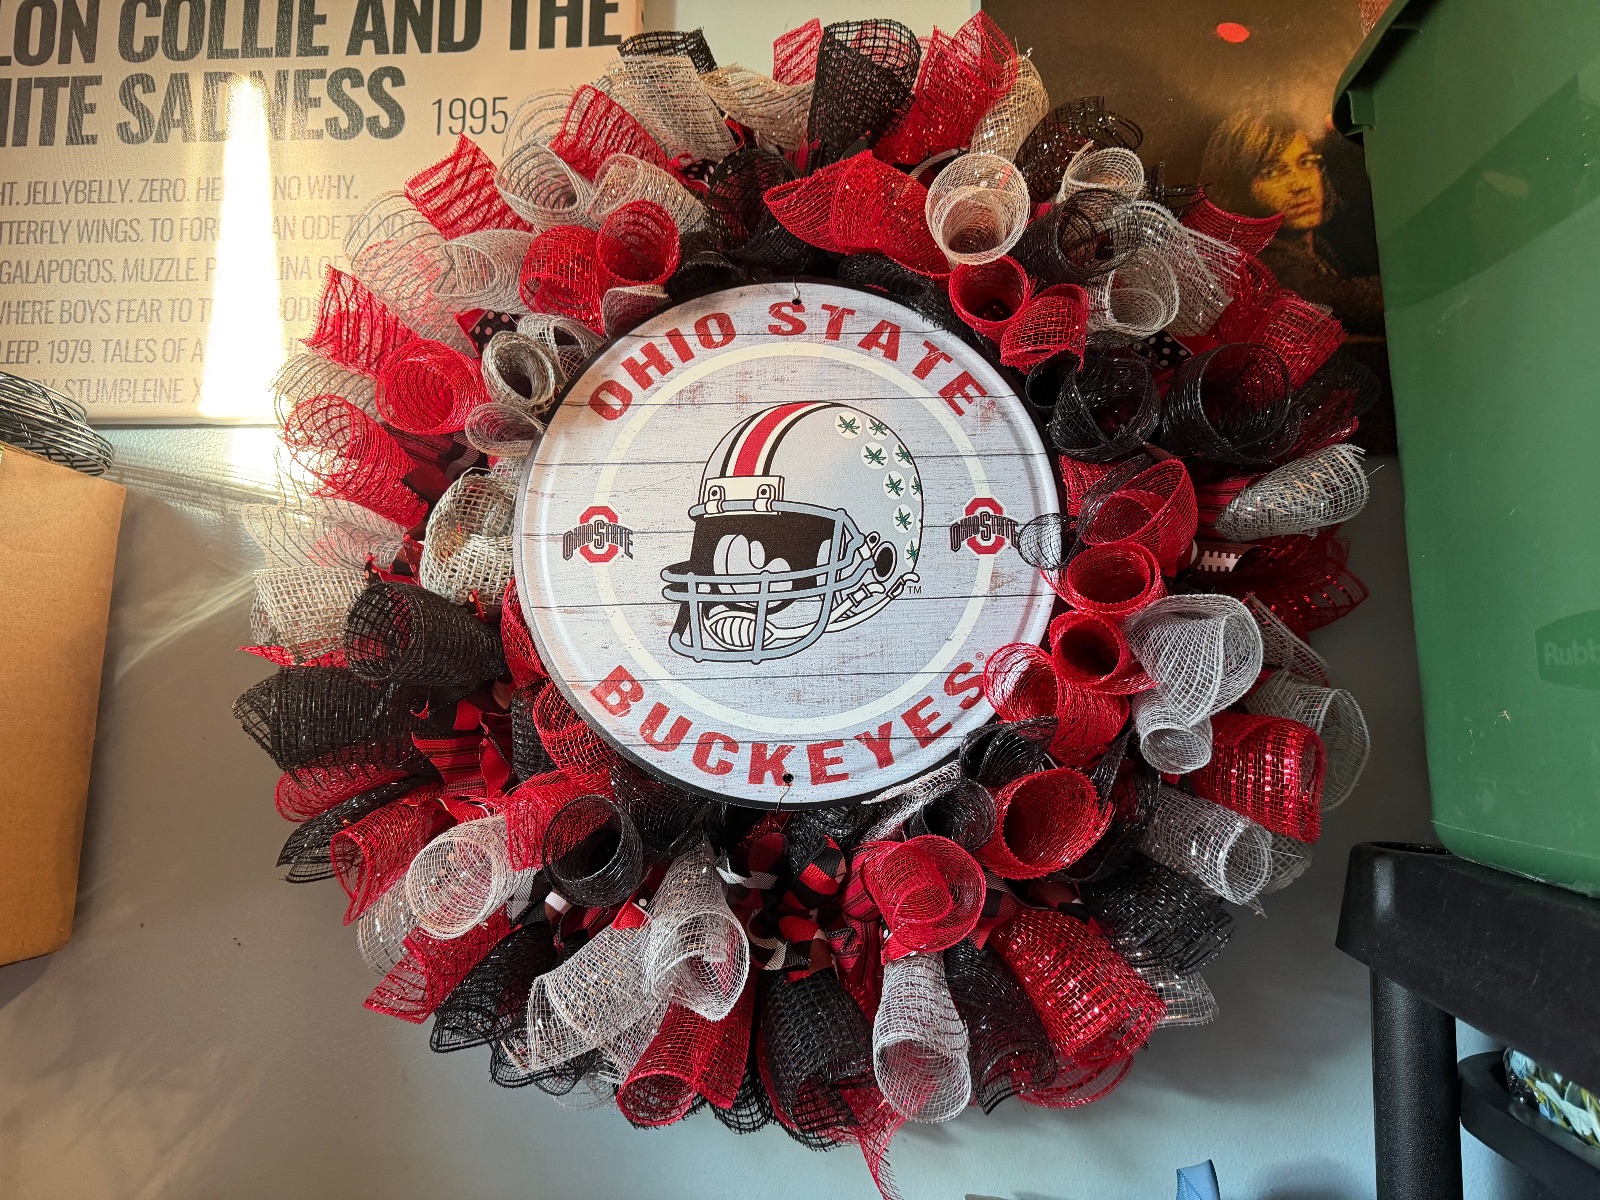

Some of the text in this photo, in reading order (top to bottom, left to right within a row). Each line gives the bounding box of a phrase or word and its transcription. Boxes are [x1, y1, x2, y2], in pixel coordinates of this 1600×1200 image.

[118, 0, 329, 63] COLLIE
[345, 0, 482, 56] AND
[510, 0, 622, 50] THE
[116, 67, 406, 145] SADNESS
[432, 96, 508, 136] 1995
[23, 178, 133, 206] JELLYBELLY.
[138, 177, 190, 203] ZERO.
[272, 175, 301, 201] NO
[307, 173, 358, 200] WHY.
[76, 218, 144, 244] WINGS.
[149, 217, 173, 243] TO
[302, 214, 341, 240] ODE
[0, 259, 117, 285] GALAPOGOS.
[59, 299, 111, 324] BOYS
[116, 298, 163, 323] FEAR
[169, 298, 194, 322] TO
[47, 339, 95, 364] 1979.
[101, 338, 157, 363] TALES
[162, 338, 188, 363] OF
[588, 301, 988, 421] OHIO STATE
[590, 661, 986, 786] BUCKEYES
